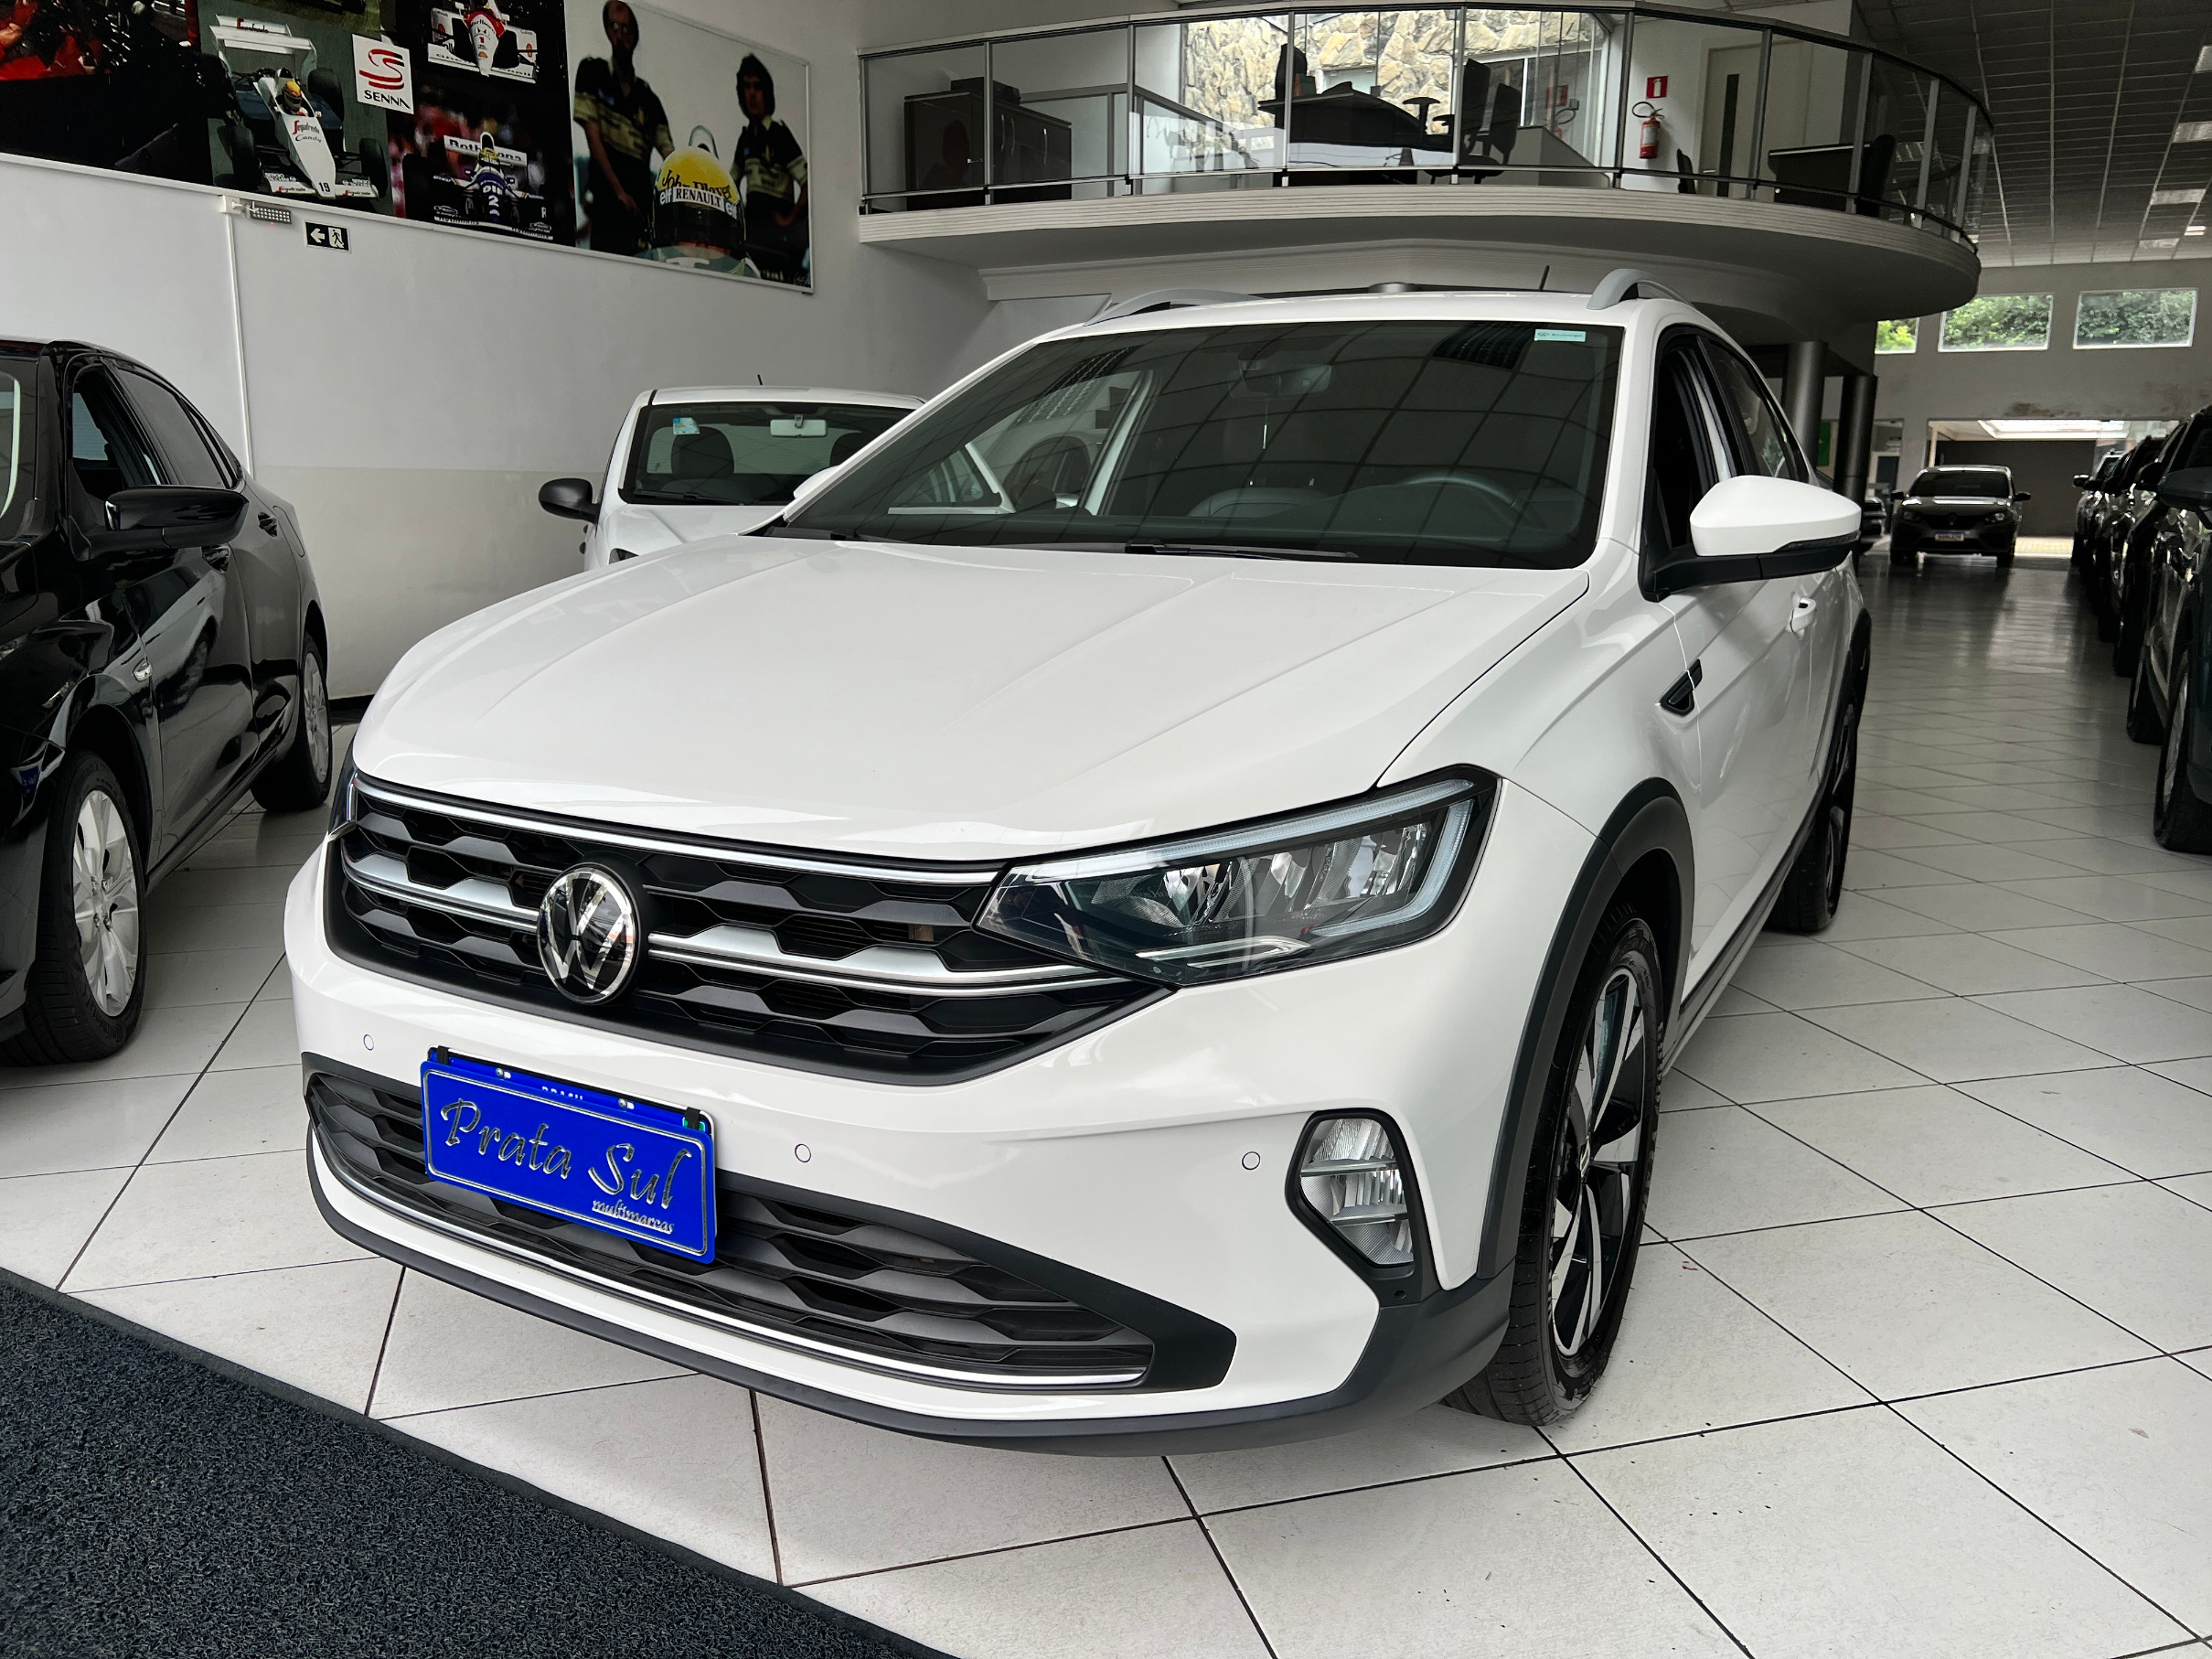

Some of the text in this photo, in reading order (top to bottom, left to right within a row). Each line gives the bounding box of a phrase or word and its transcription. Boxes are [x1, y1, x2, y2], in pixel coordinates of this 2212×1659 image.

[364, 90, 411, 110] SENNA
[318, 182, 331, 193] 19
[676, 187, 721, 208] RENAULT
[487, 195, 500, 208] 2
[440, 1097, 692, 1209] Prata Sul
[592, 1199, 675, 1235] multimarcas
